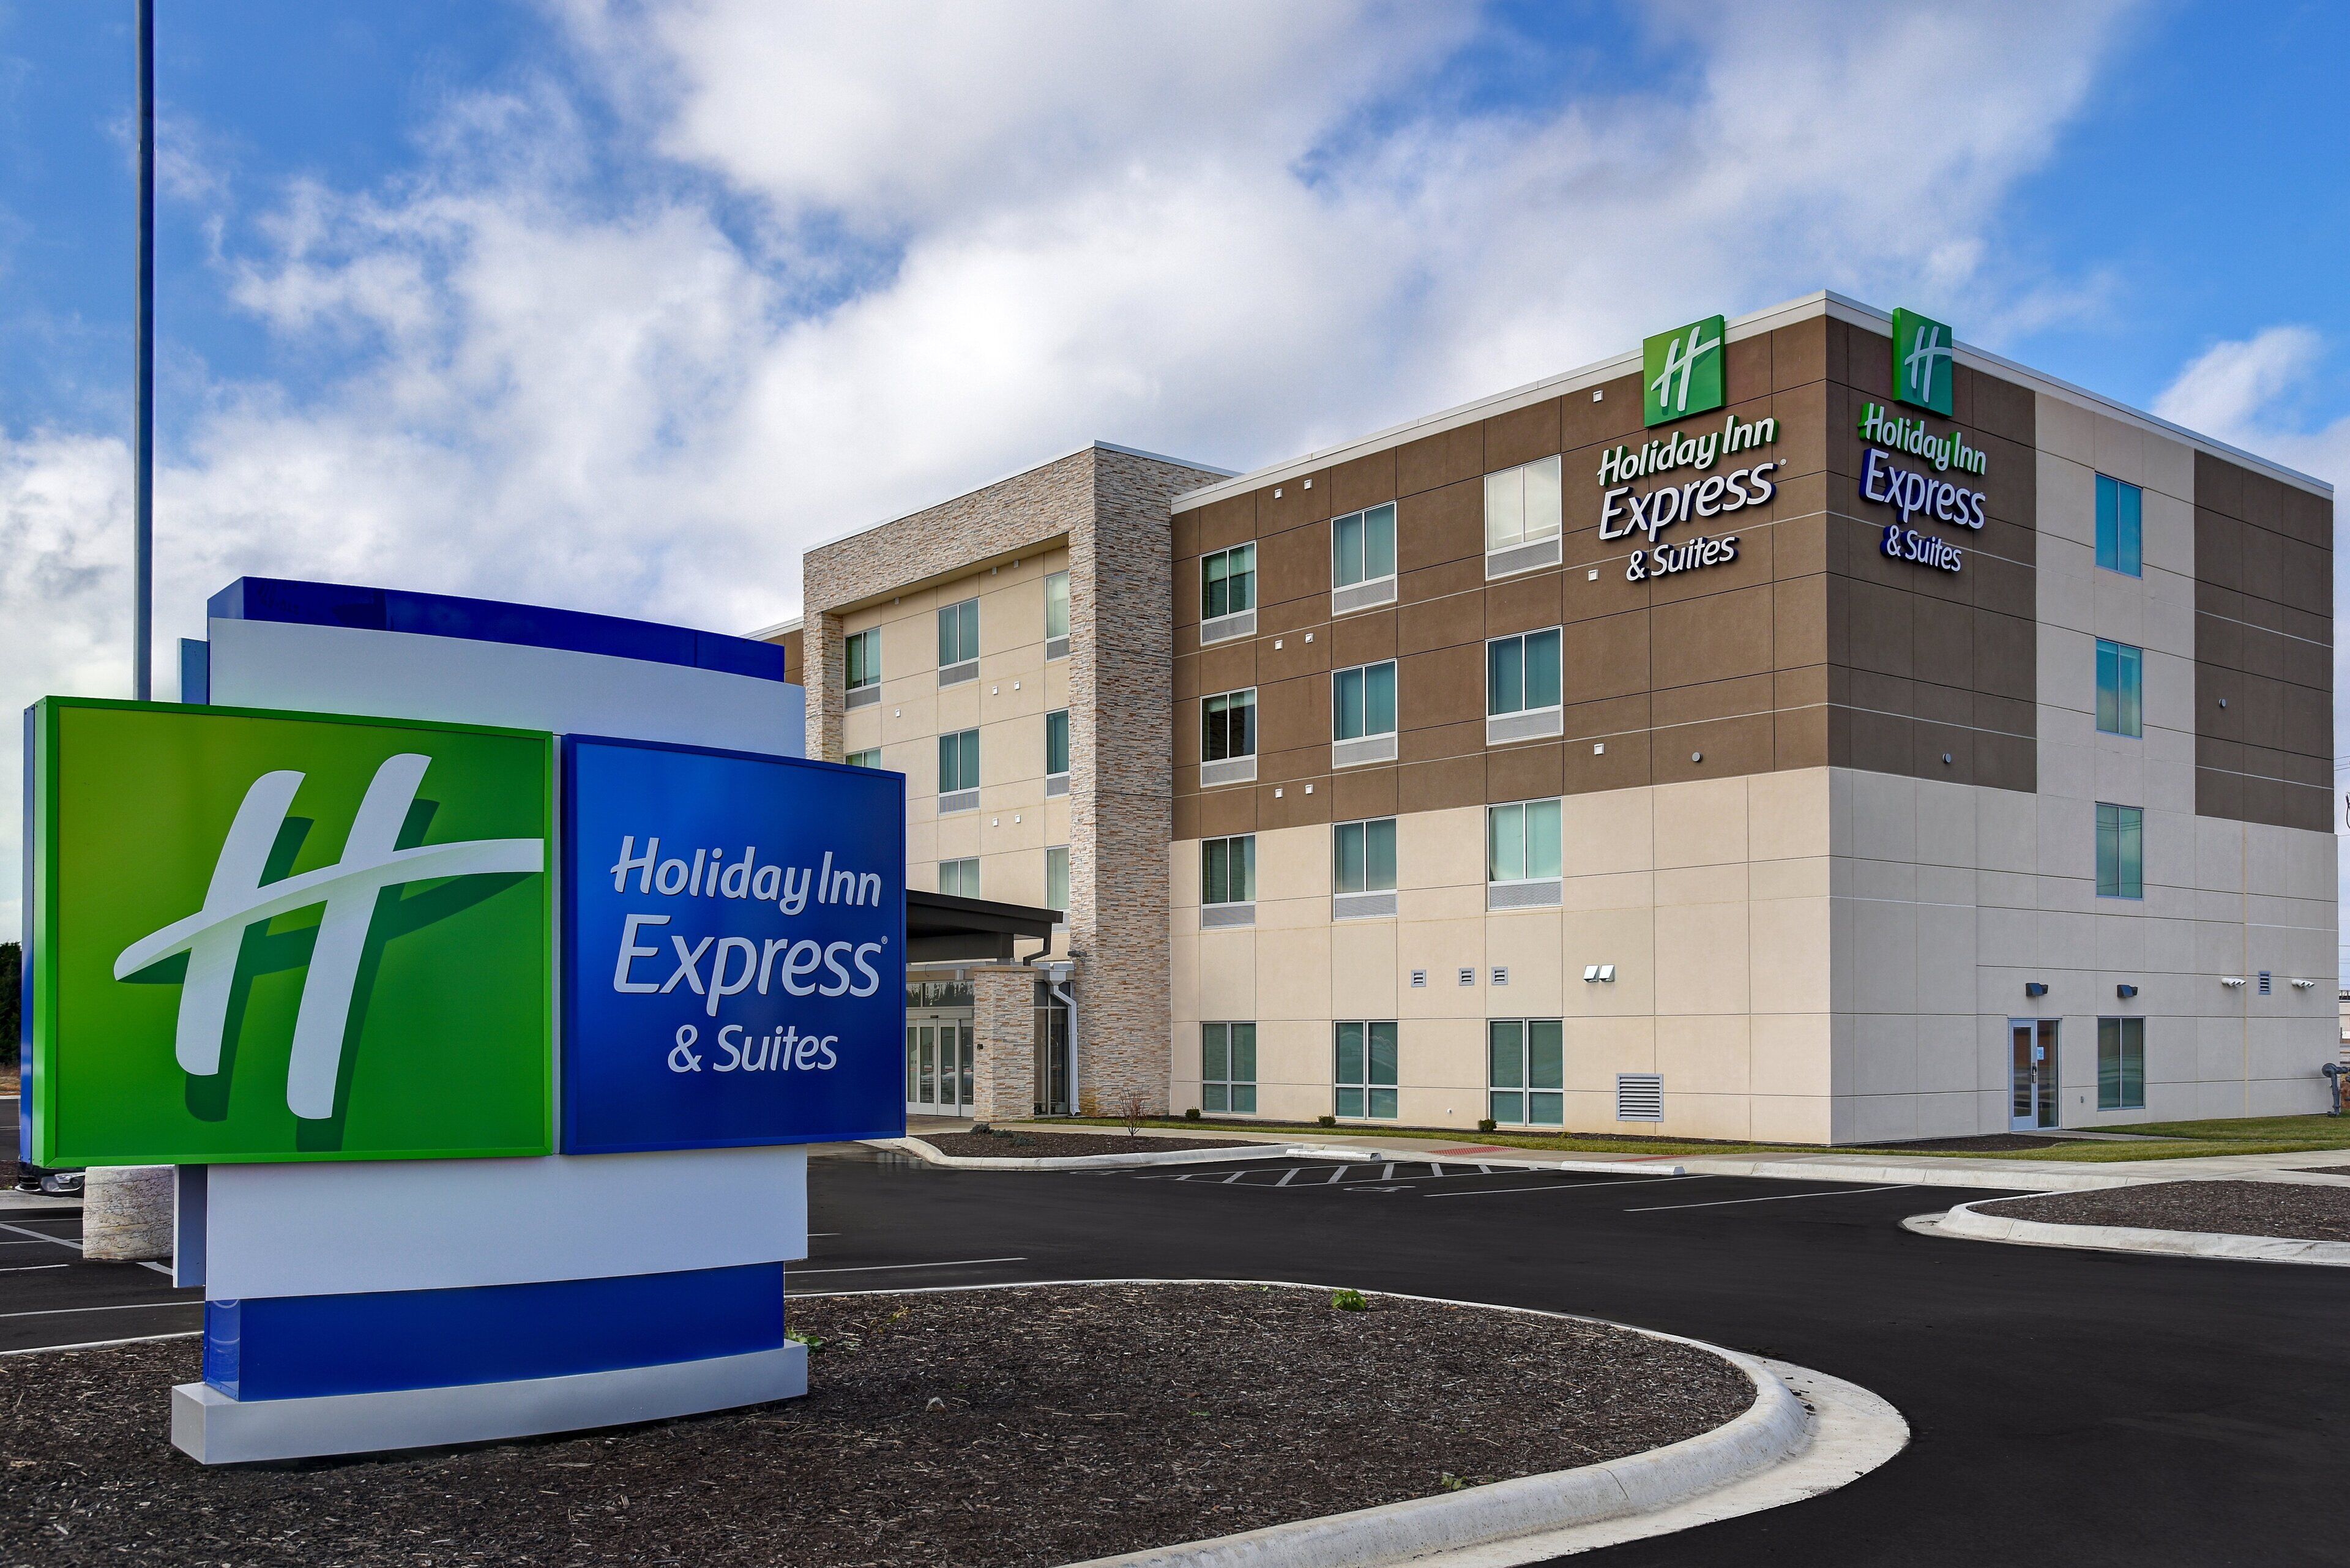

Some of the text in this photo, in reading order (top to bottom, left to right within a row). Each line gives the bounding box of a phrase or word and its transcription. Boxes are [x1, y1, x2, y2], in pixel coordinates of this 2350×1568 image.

[1597, 414, 1777, 487] Holiday Inn
[1862, 402, 1987, 476] Holiday Inn
[1598, 462, 1777, 542] Express
[1863, 447, 1986, 530] Express
[1625, 536, 1738, 582] & Suites
[1884, 525, 1963, 572] & Suites
[610, 835, 881, 916] Holiday Inn
[613, 914, 881, 1017] Express
[668, 1024, 838, 1073] & Suites
